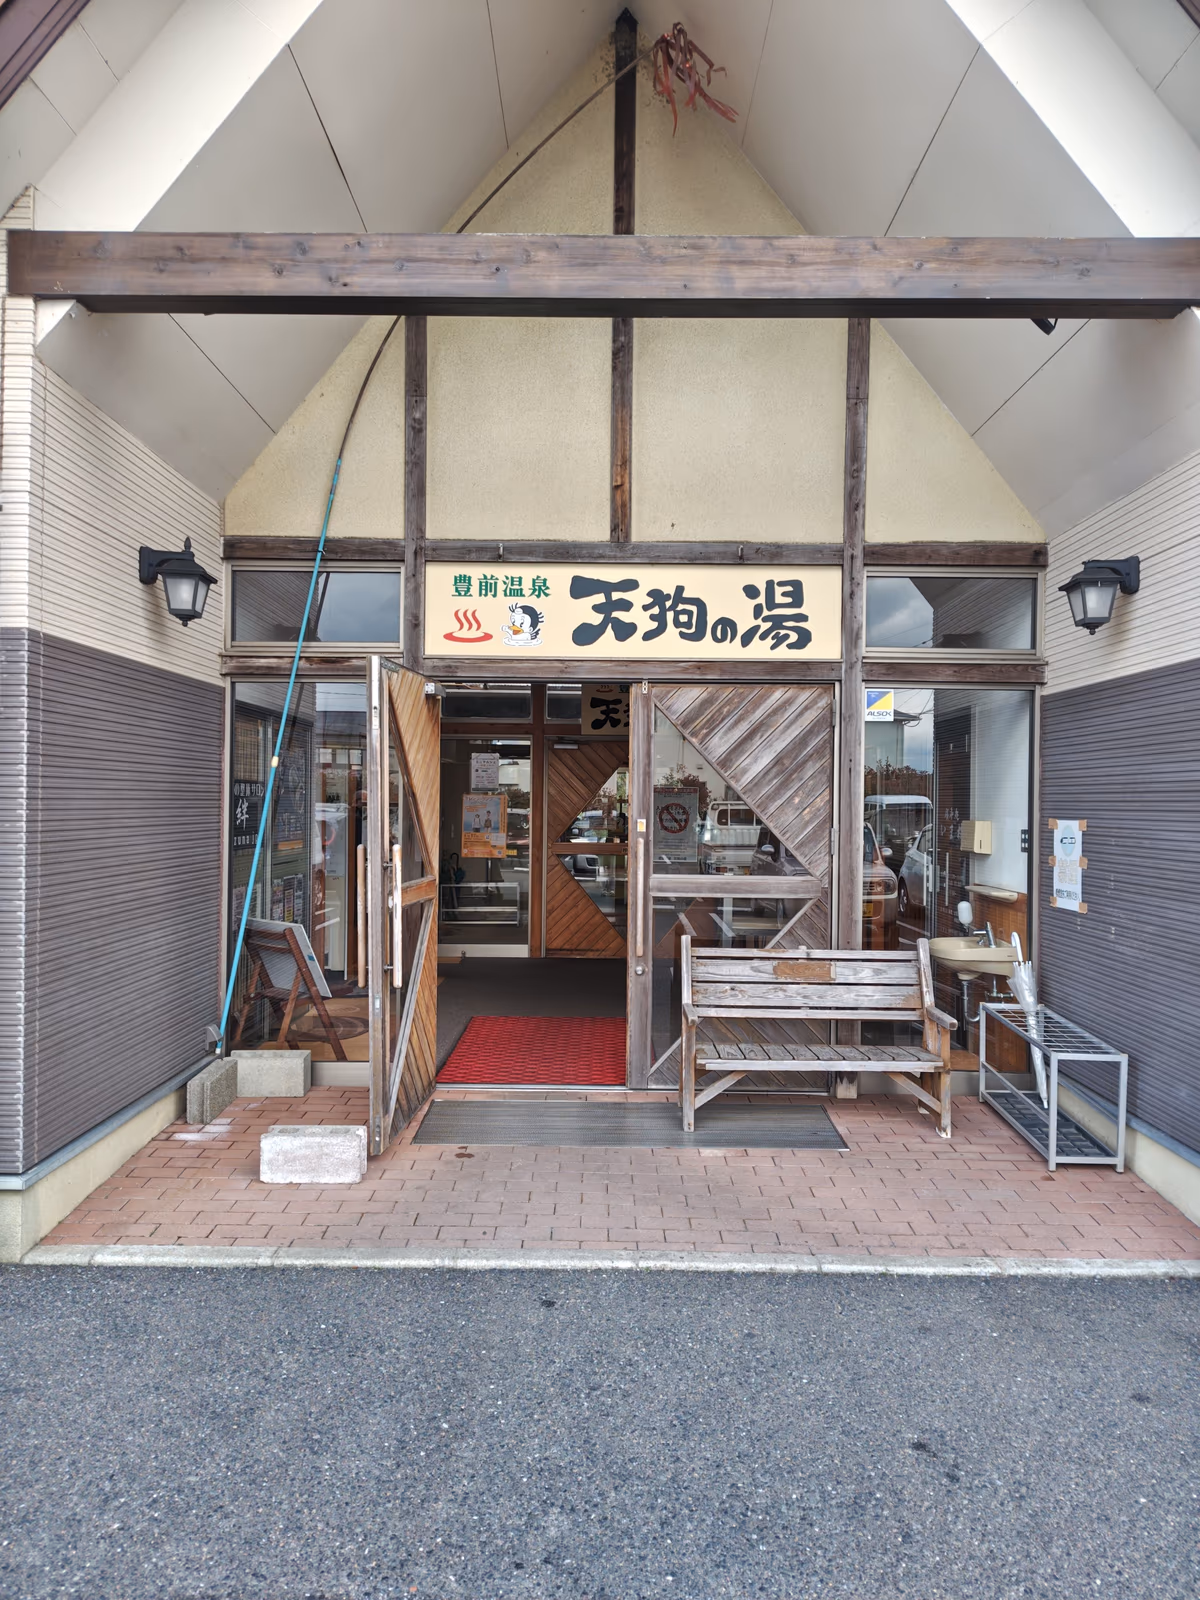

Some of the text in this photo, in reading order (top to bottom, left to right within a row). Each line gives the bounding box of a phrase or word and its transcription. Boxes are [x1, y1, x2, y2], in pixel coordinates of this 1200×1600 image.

[451, 573, 552, 599] 豊前温泉
[570, 575, 812, 650] 天狗の湯
[590, 696, 630, 730] 天
